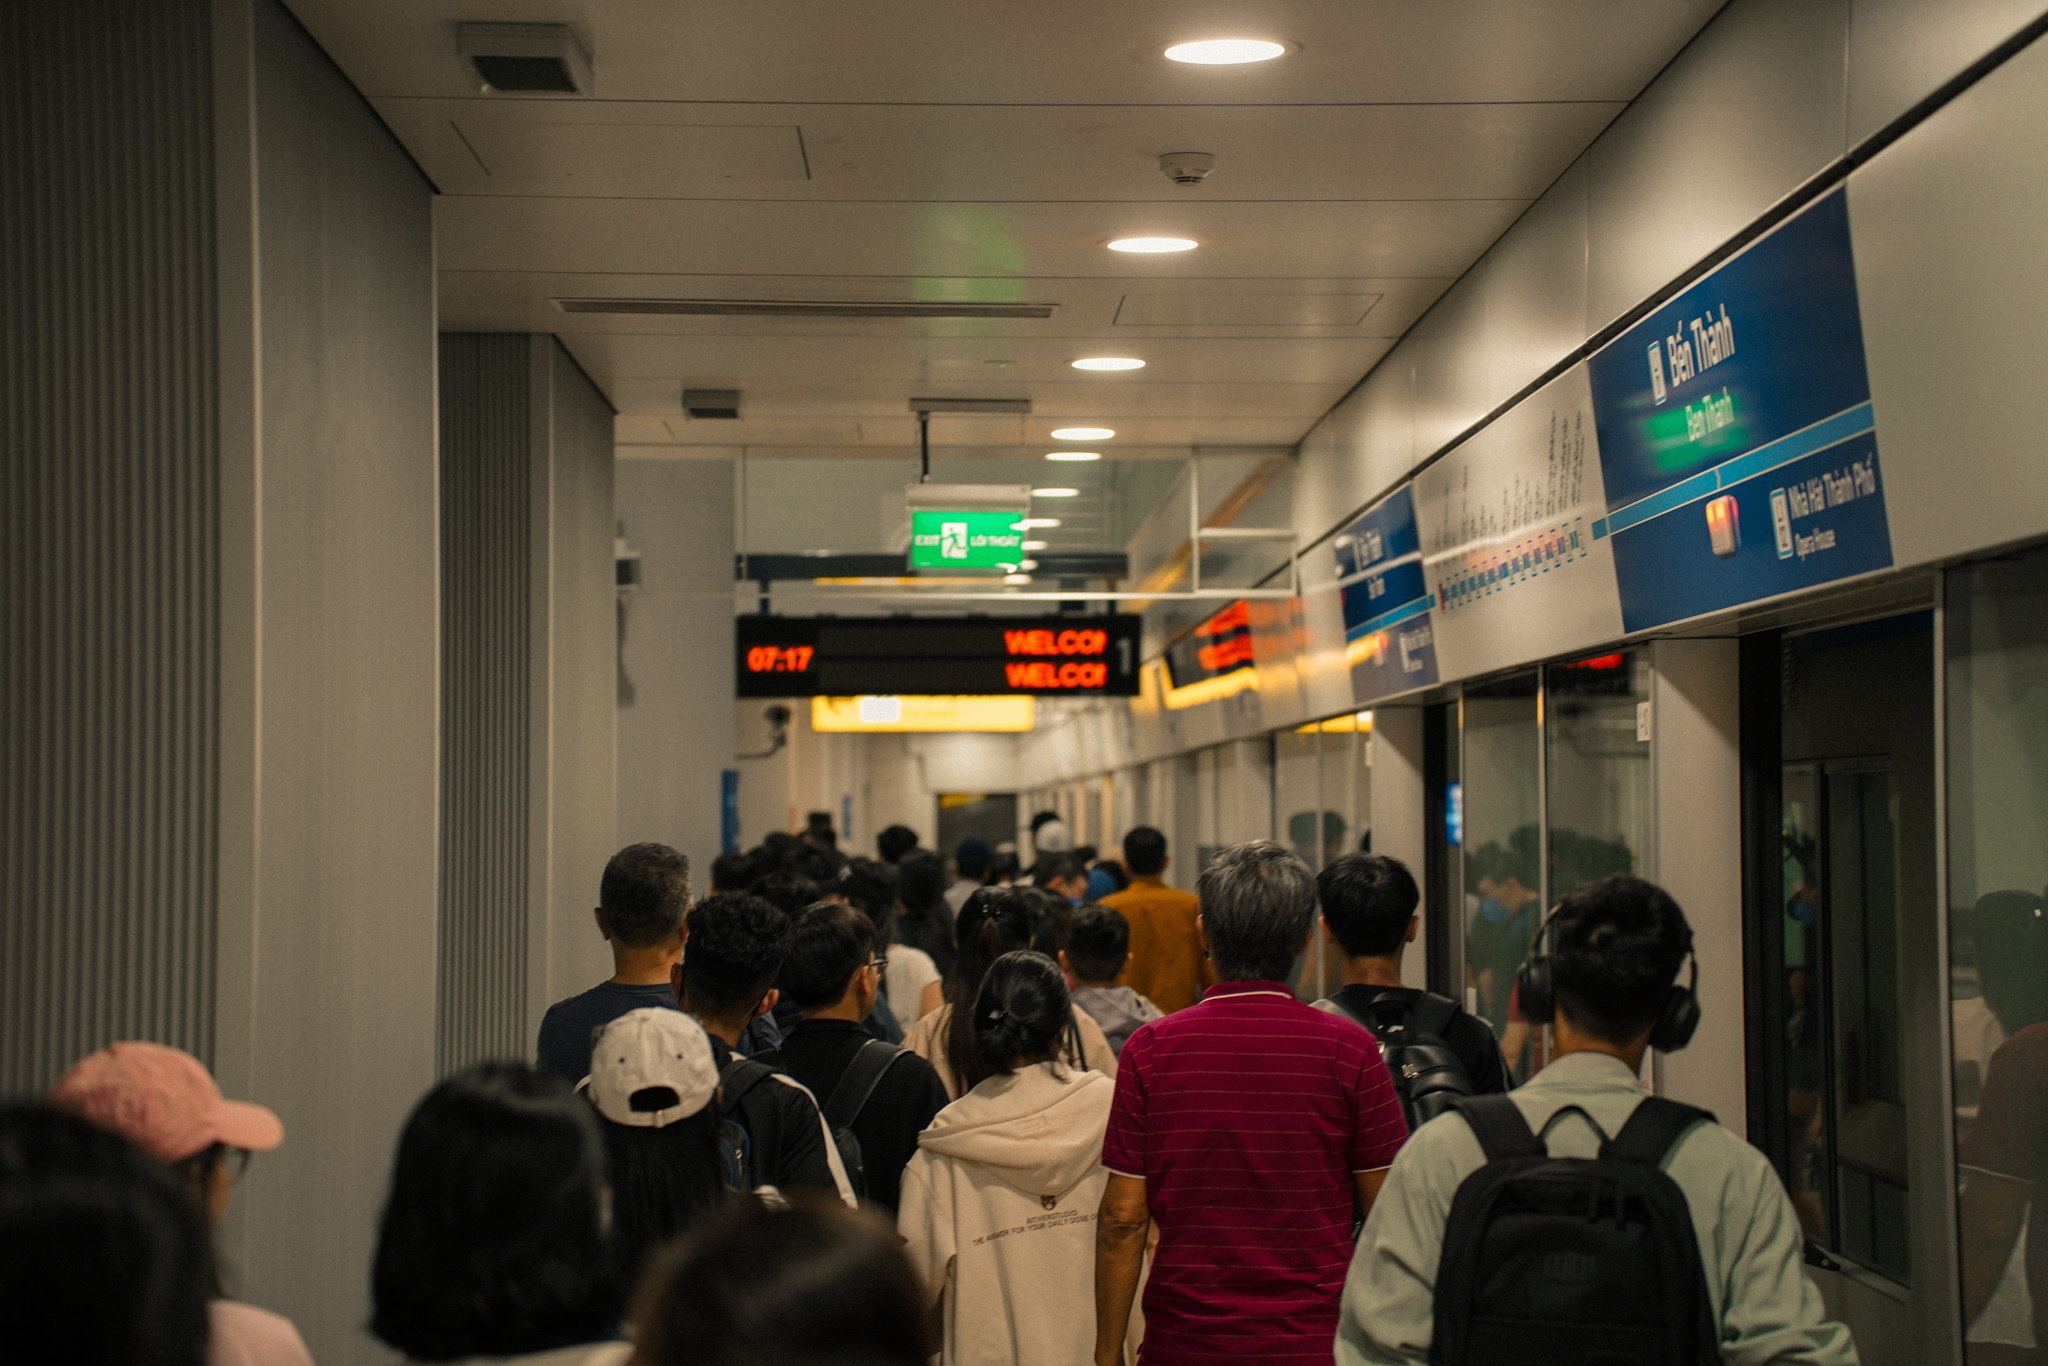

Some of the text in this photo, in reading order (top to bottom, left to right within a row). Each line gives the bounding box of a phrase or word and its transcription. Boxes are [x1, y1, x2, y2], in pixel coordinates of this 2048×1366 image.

[1666, 320, 1695, 388] Bến
[1690, 302, 1735, 373] Thành
[1685, 386, 1734, 442] Ben Thanh
[1822, 467, 1855, 508] Thành
[915, 535, 941, 546] EXIT
[747, 646, 814, 672] 07:17
[1116, 638, 1130, 675] 1
[1011, 1225, 1025, 1234] FOR
[1027, 1222, 1045, 1232] YOUR
